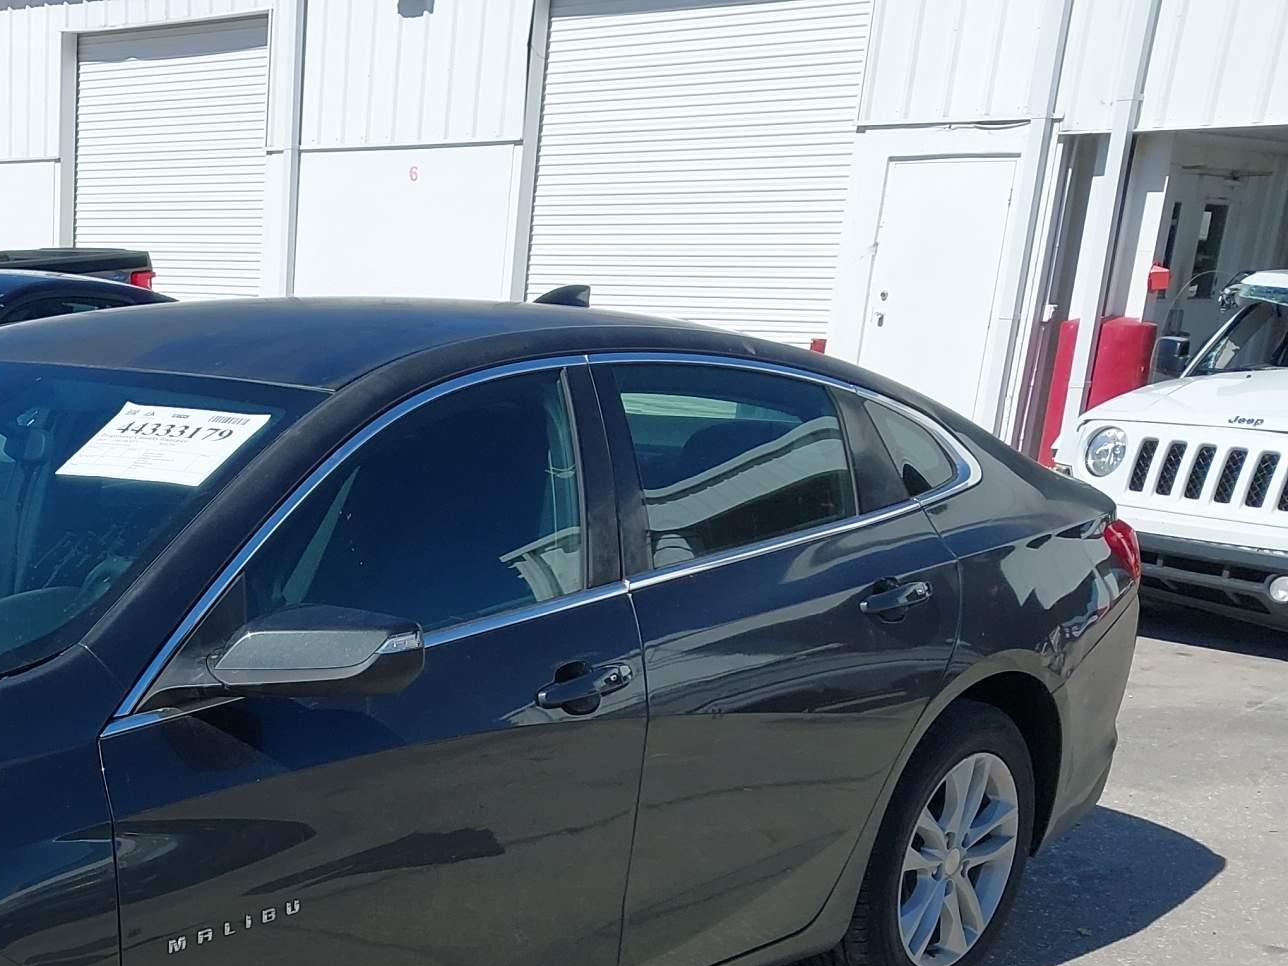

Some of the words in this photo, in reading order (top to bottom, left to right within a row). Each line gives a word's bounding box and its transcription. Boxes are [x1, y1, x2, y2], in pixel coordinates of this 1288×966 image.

[409, 166, 418, 182] 6
[1228, 415, 1265, 427] Jeep
[116, 421, 234, 442] 44333179
[167, 899, 300, 955] MALIBU
